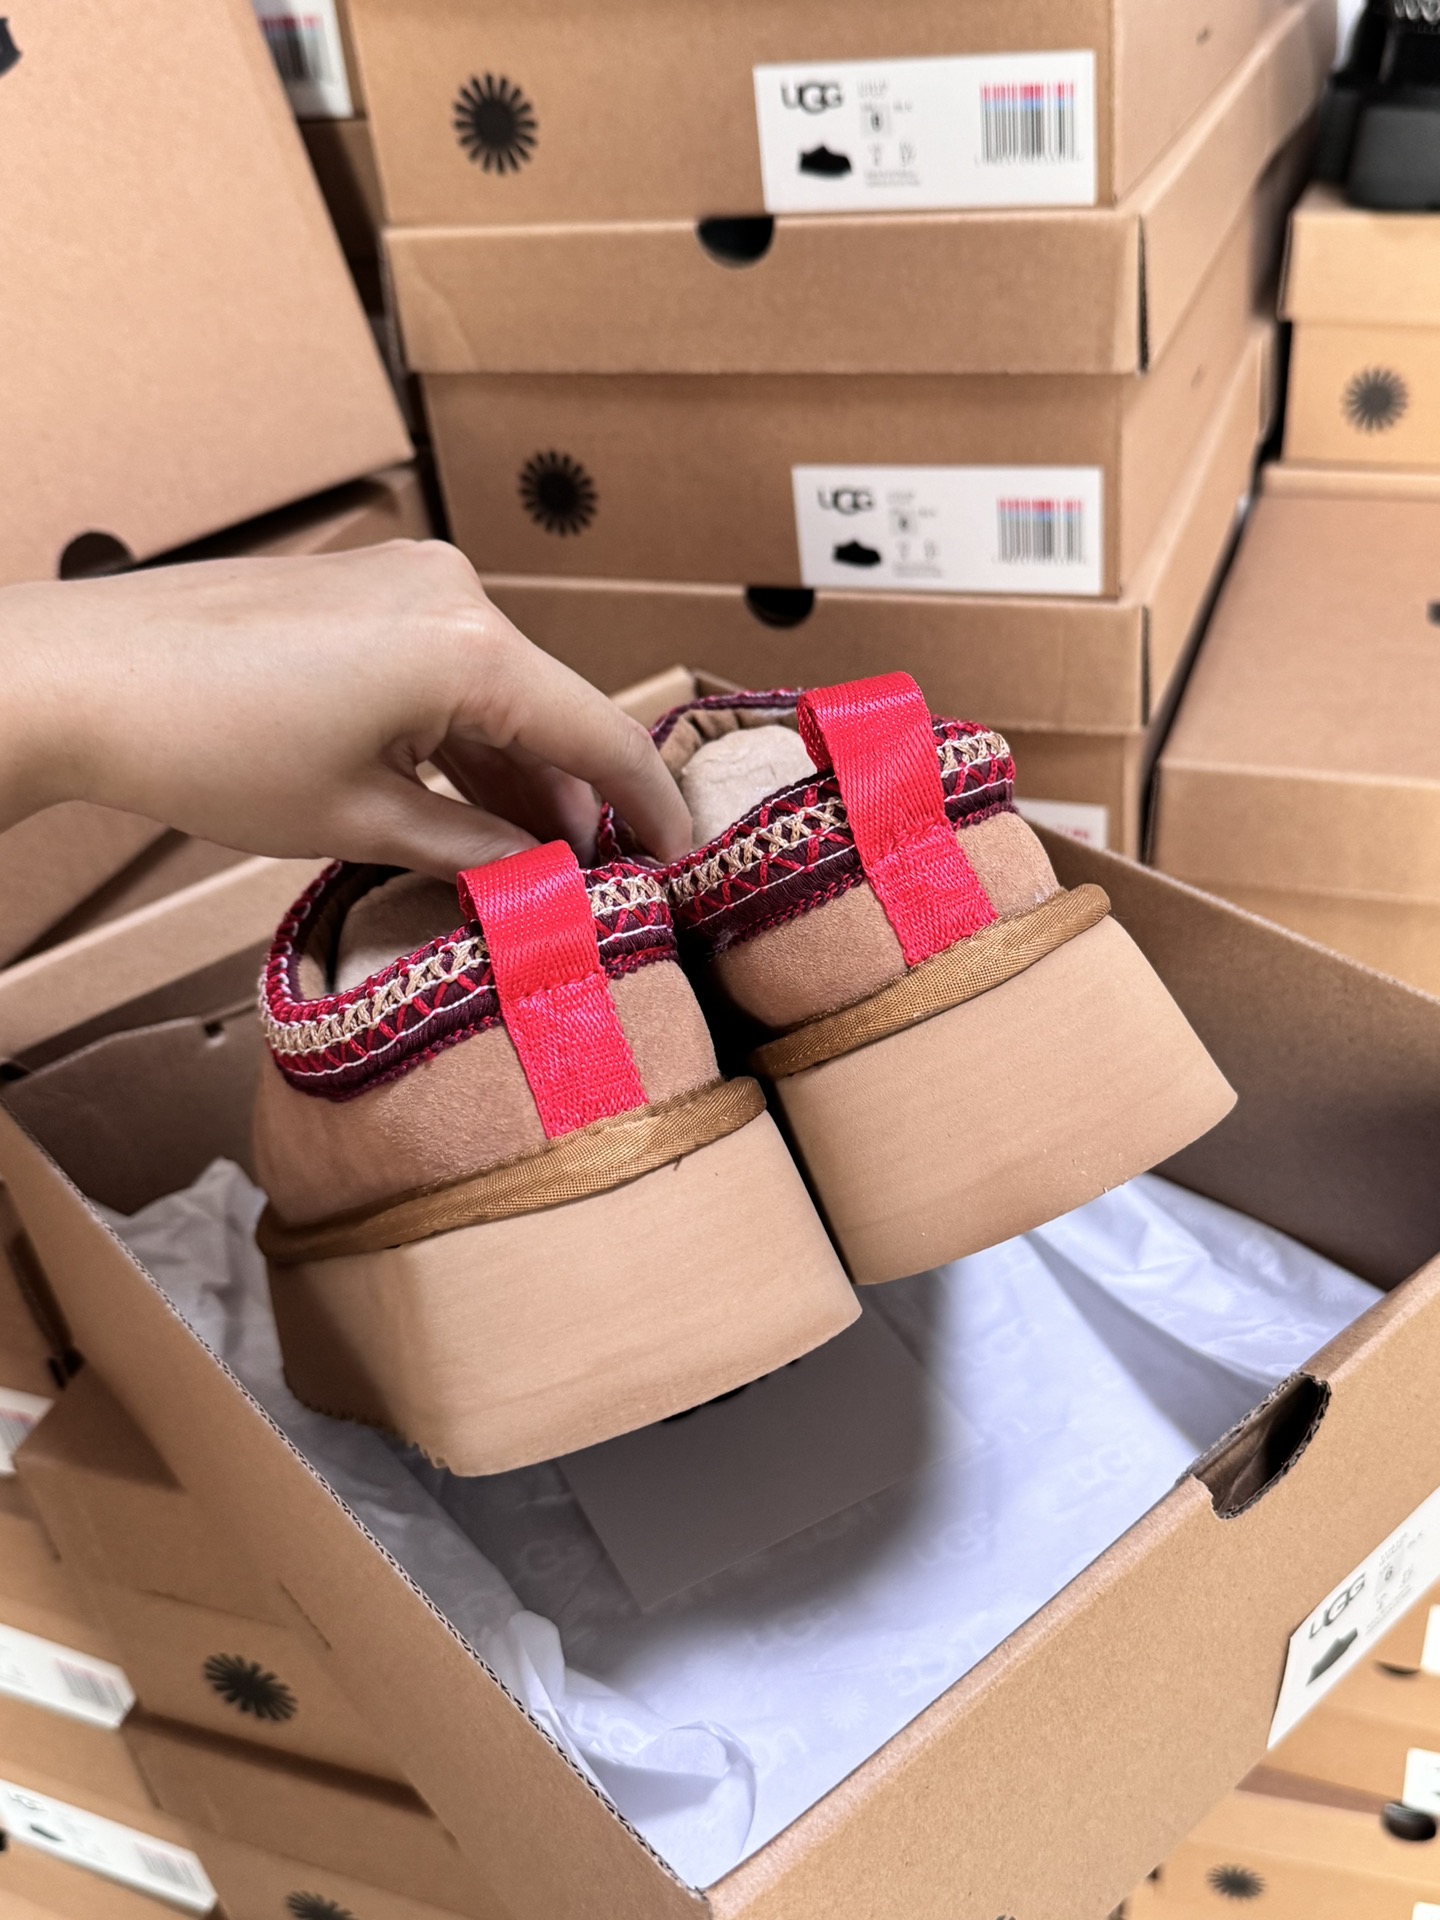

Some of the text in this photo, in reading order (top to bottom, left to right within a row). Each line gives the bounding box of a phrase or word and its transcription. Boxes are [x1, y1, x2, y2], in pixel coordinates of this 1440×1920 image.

[780, 80, 845, 115] UGG
[817, 487, 873, 515] UGG
[1308, 1570, 1365, 1639] UGG
